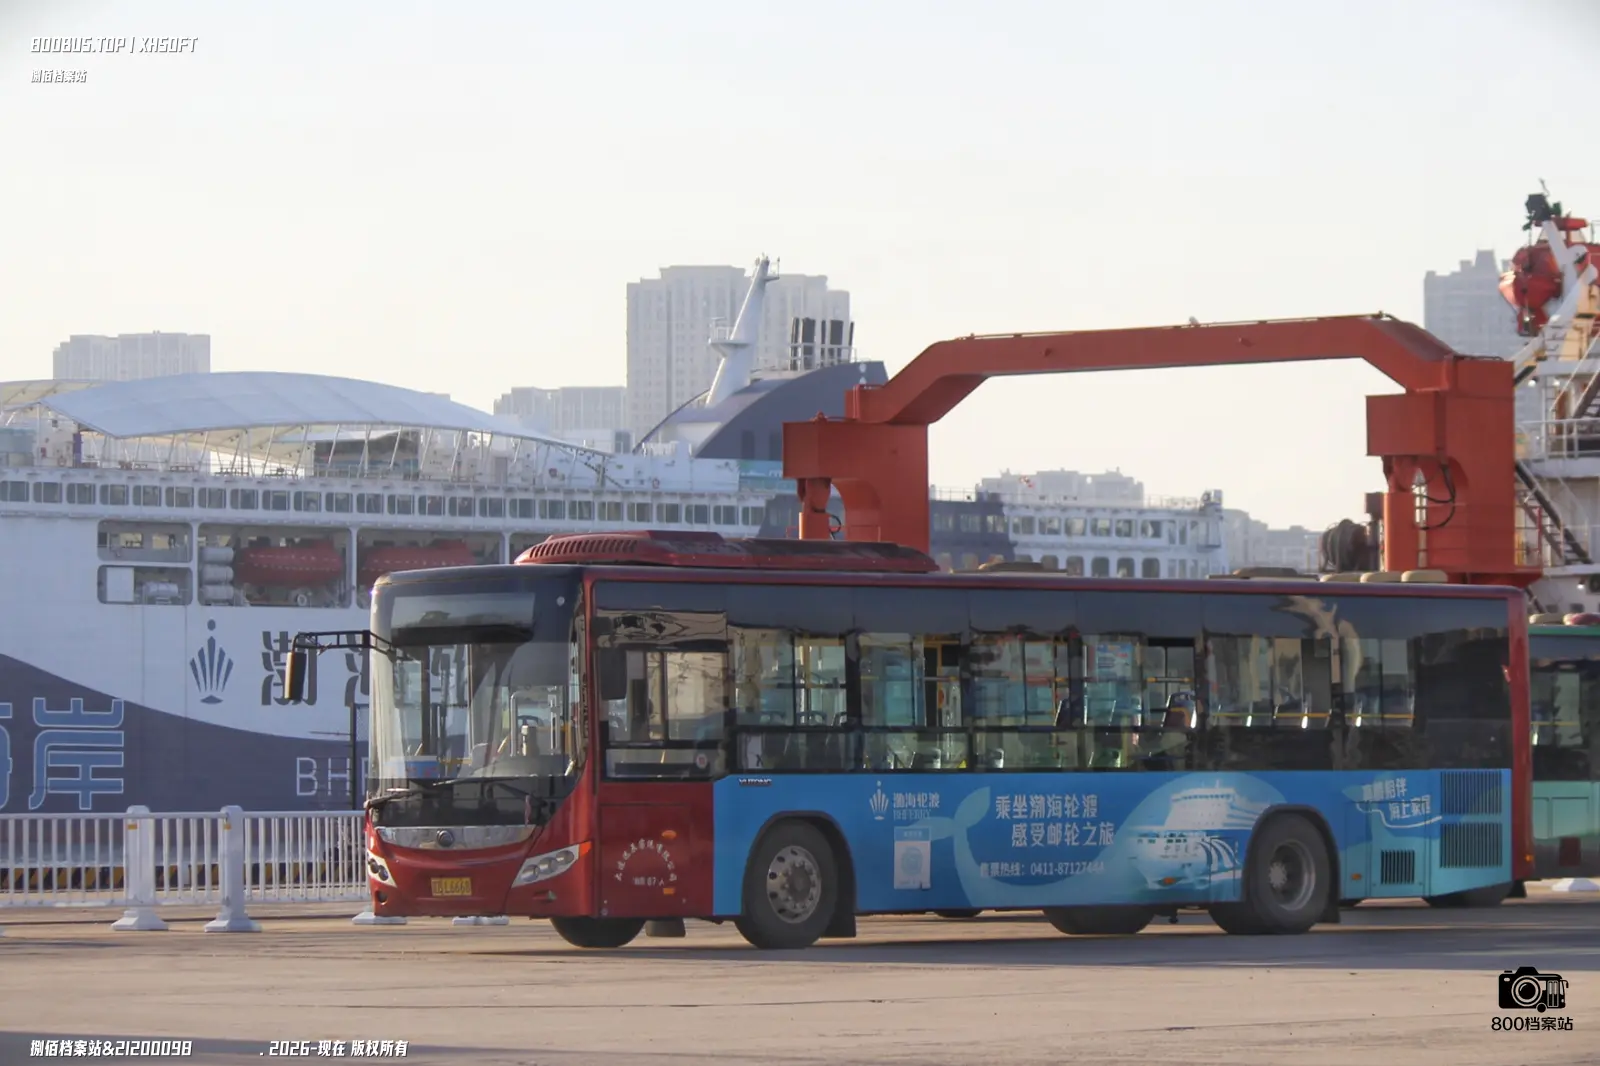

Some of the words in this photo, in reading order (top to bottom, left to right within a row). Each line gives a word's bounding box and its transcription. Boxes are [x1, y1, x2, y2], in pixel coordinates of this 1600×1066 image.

[0, 697, 125, 809] 岸
[995, 794, 1099, 820] 乘坐渤海轮渡
[1011, 821, 1115, 848] 感受邮轮之旅
